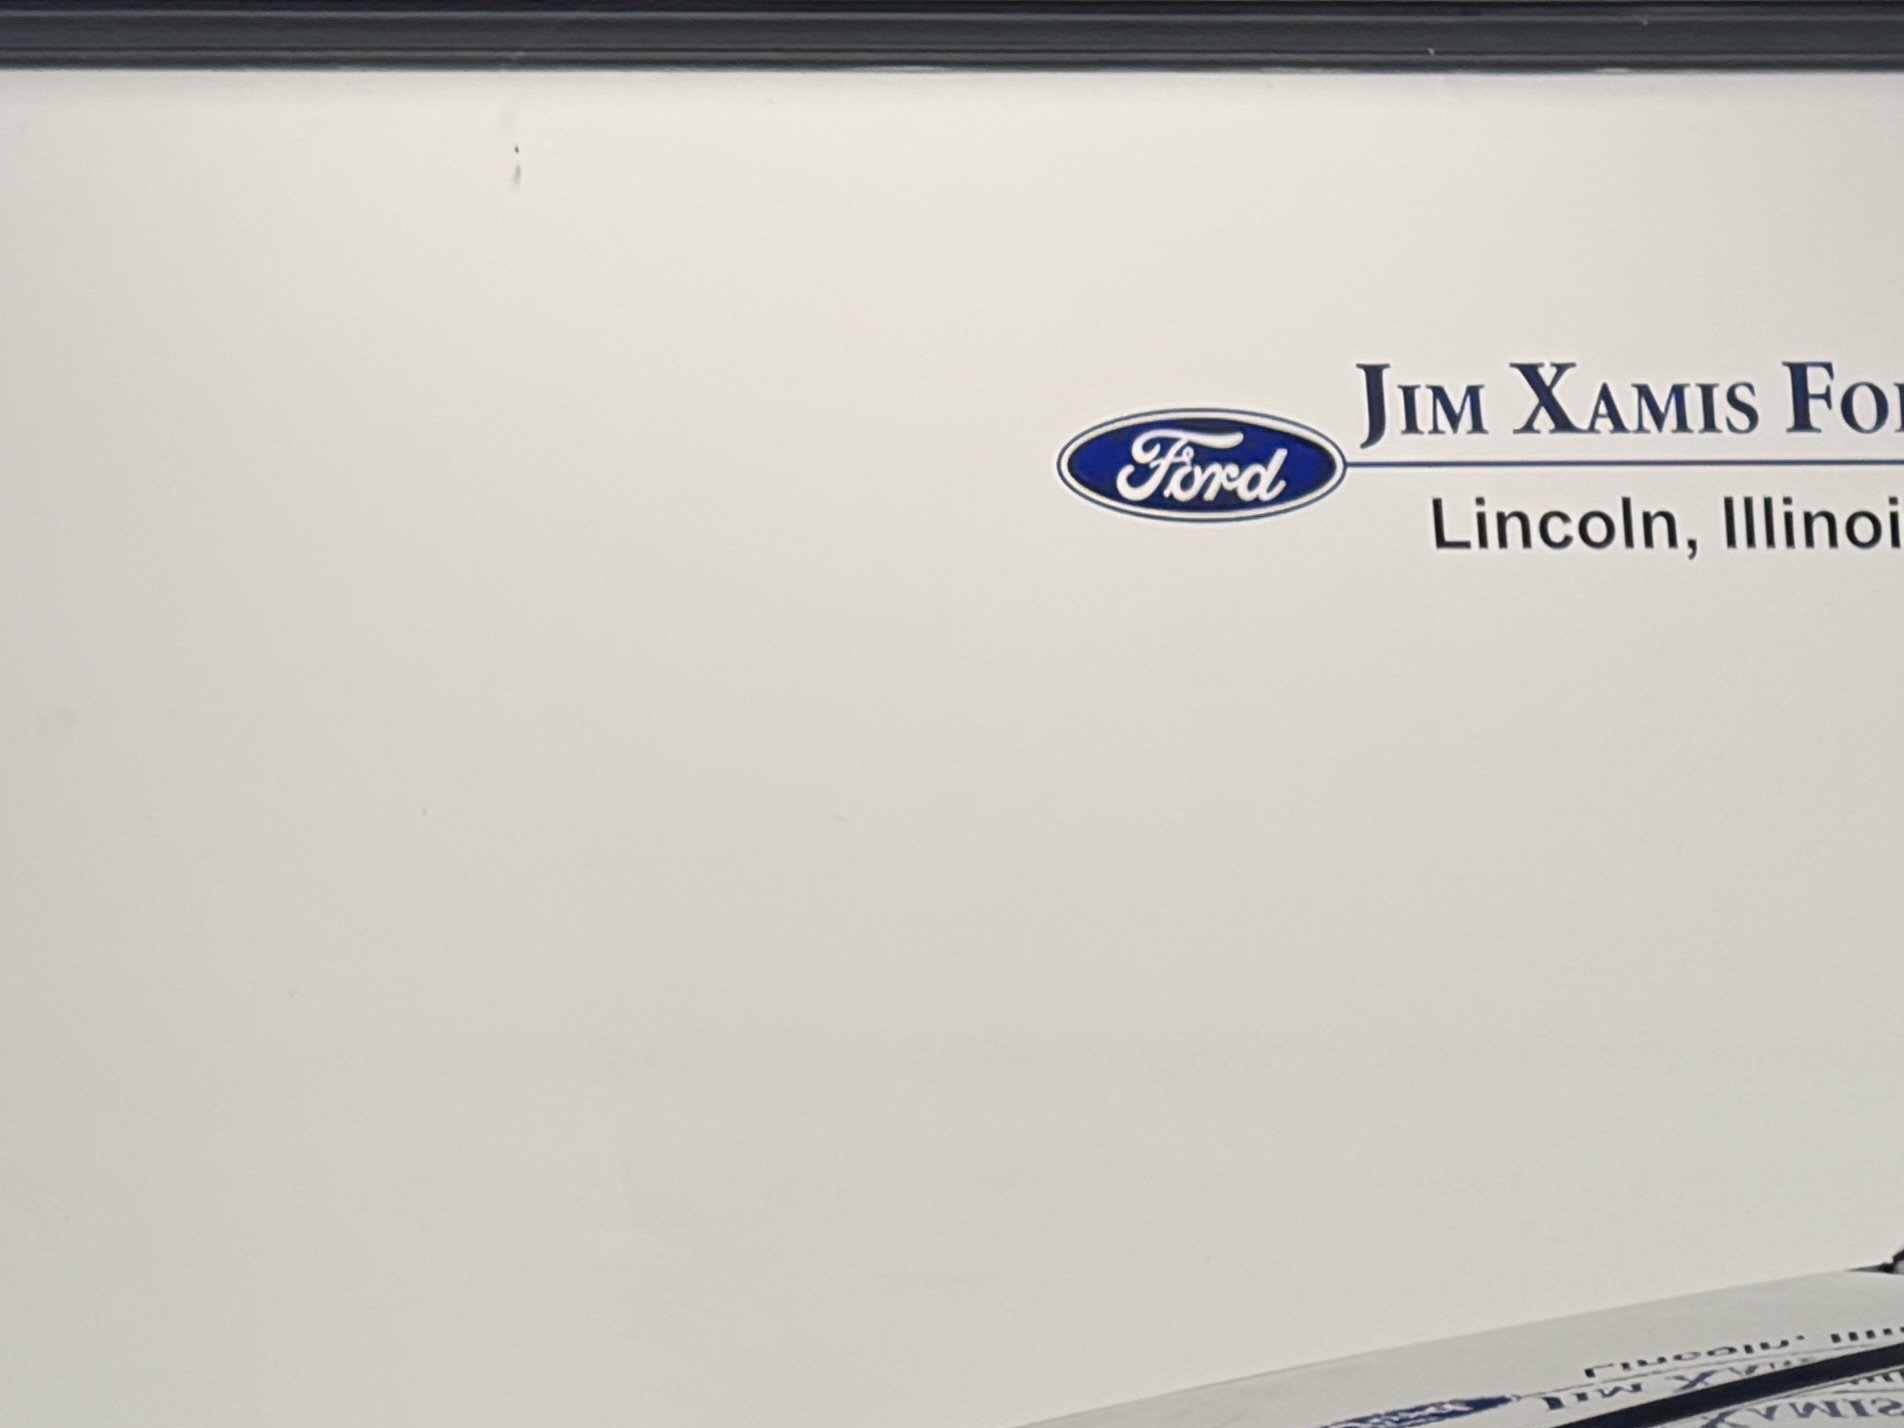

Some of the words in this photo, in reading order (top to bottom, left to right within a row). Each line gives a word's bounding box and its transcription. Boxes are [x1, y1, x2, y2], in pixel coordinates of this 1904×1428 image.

[1358, 362, 1486, 449] JIM
[1508, 361, 1758, 434] XAMIS
[1116, 428, 1287, 503] Ford
[1432, 497, 1700, 559] Lincoln,
